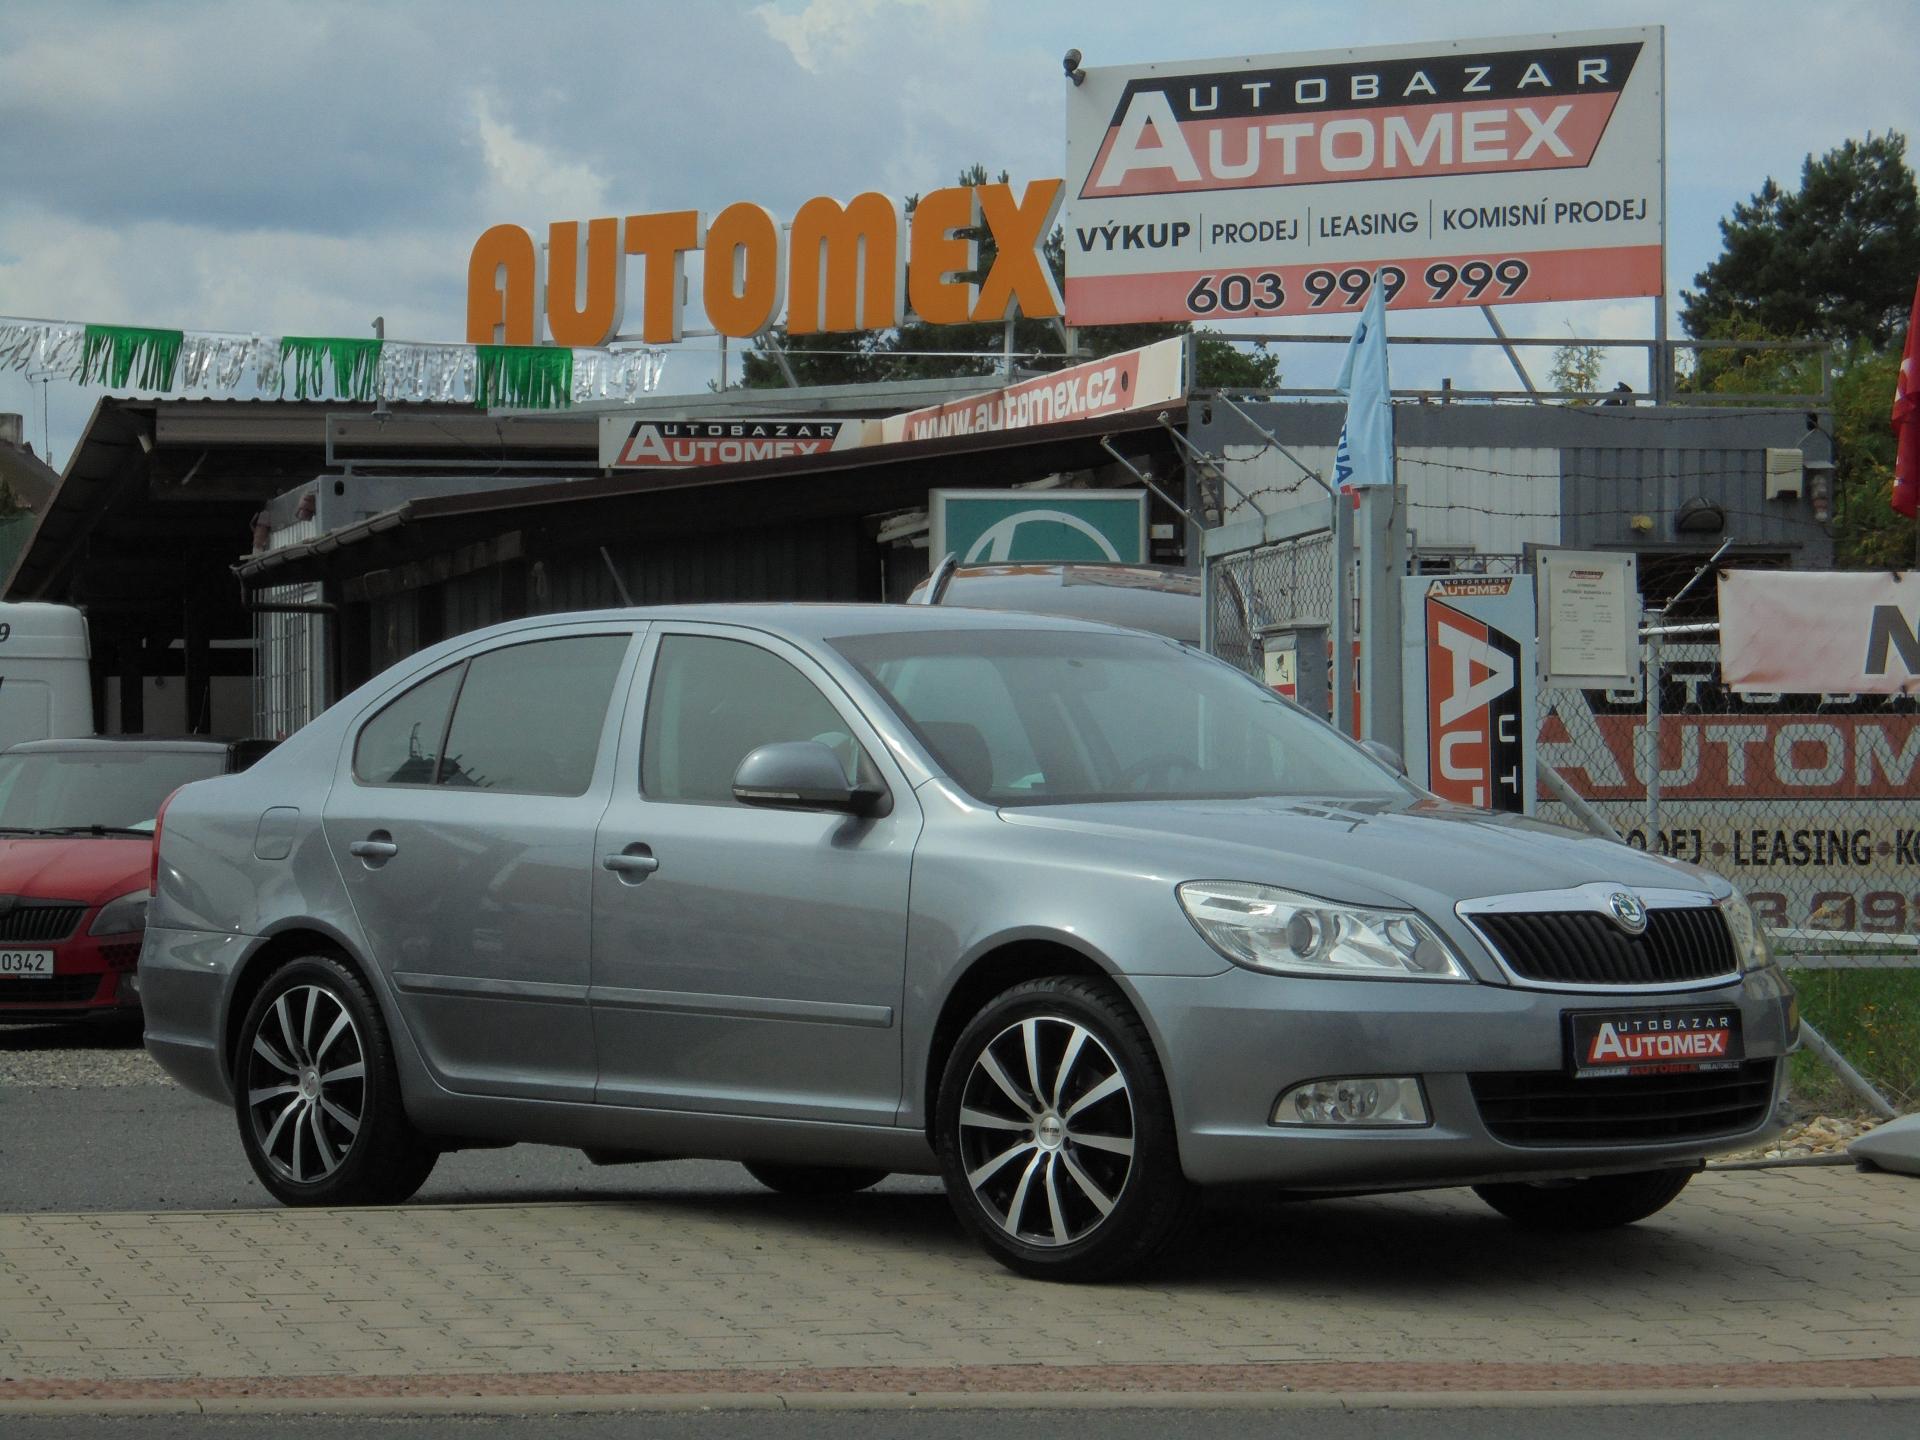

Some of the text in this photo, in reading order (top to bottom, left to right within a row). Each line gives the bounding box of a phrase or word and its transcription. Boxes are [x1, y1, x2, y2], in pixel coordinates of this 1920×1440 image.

[1095, 91, 1575, 188] AUTOMEX
[1075, 197, 1647, 252] VÝKUP PRODEJ LEASING KOMISNÍ PRODEJ
[466, 178, 1067, 347] AUTOMEX
[1186, 258, 1530, 314] 603 999 999
[1428, 580, 1506, 596] AUTOMEX
[1733, 828, 1872, 867] LEASING
[1, 952, 46, 972] 0342
[1592, 1022, 1724, 1060] AUTOMEX
